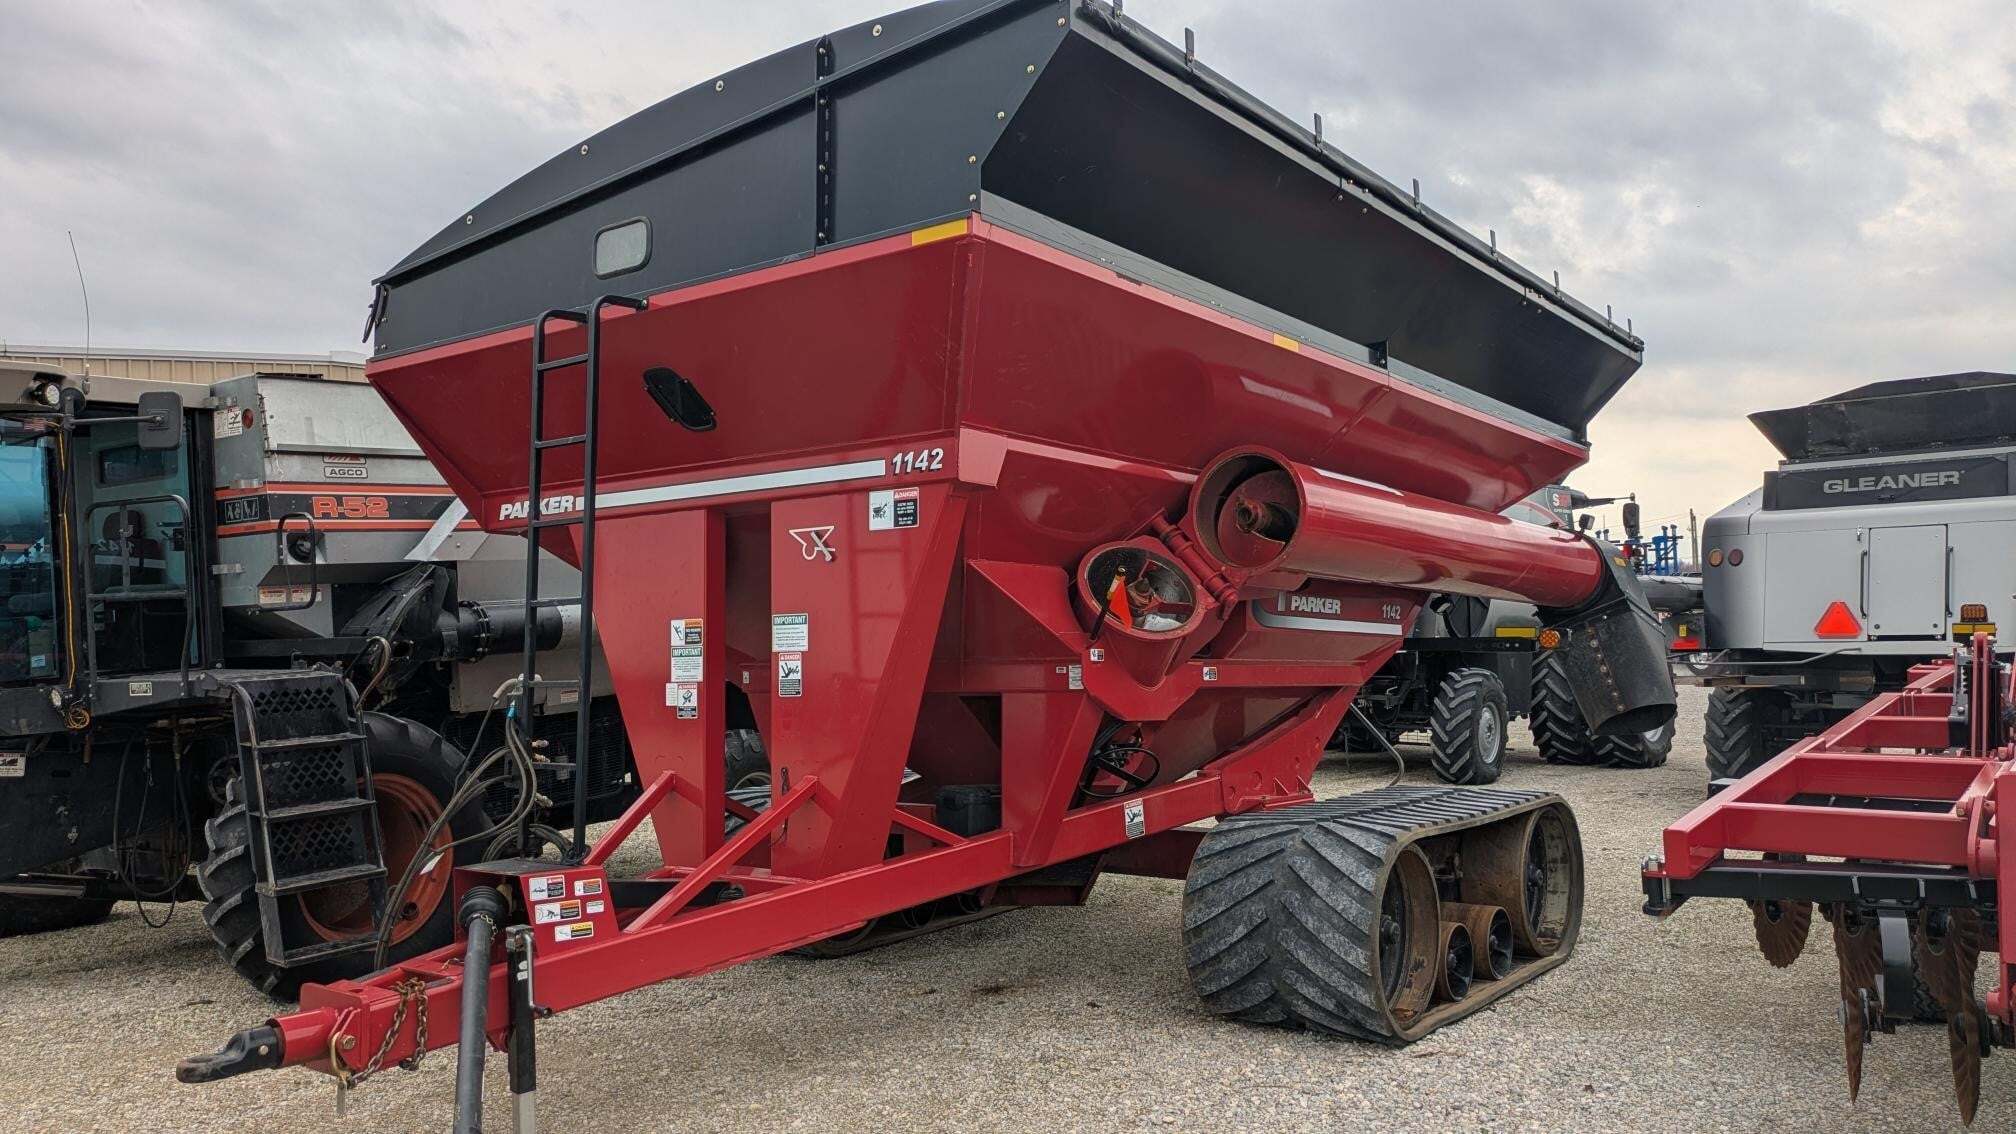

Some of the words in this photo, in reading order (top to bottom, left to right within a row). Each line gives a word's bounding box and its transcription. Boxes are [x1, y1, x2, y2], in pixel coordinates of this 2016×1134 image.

[892, 447, 944, 474] 1142
[329, 468, 363, 477] AGCO
[1823, 470, 1961, 494] GLEANER
[898, 490, 917, 499] DANGER
[312, 496, 390, 518] R-52
[1290, 595, 1341, 615] PARKER
[1381, 603, 1401, 620] 1142
[774, 615, 806, 625] IMPORTANT
[672, 647, 702, 658] IMPORTANT
